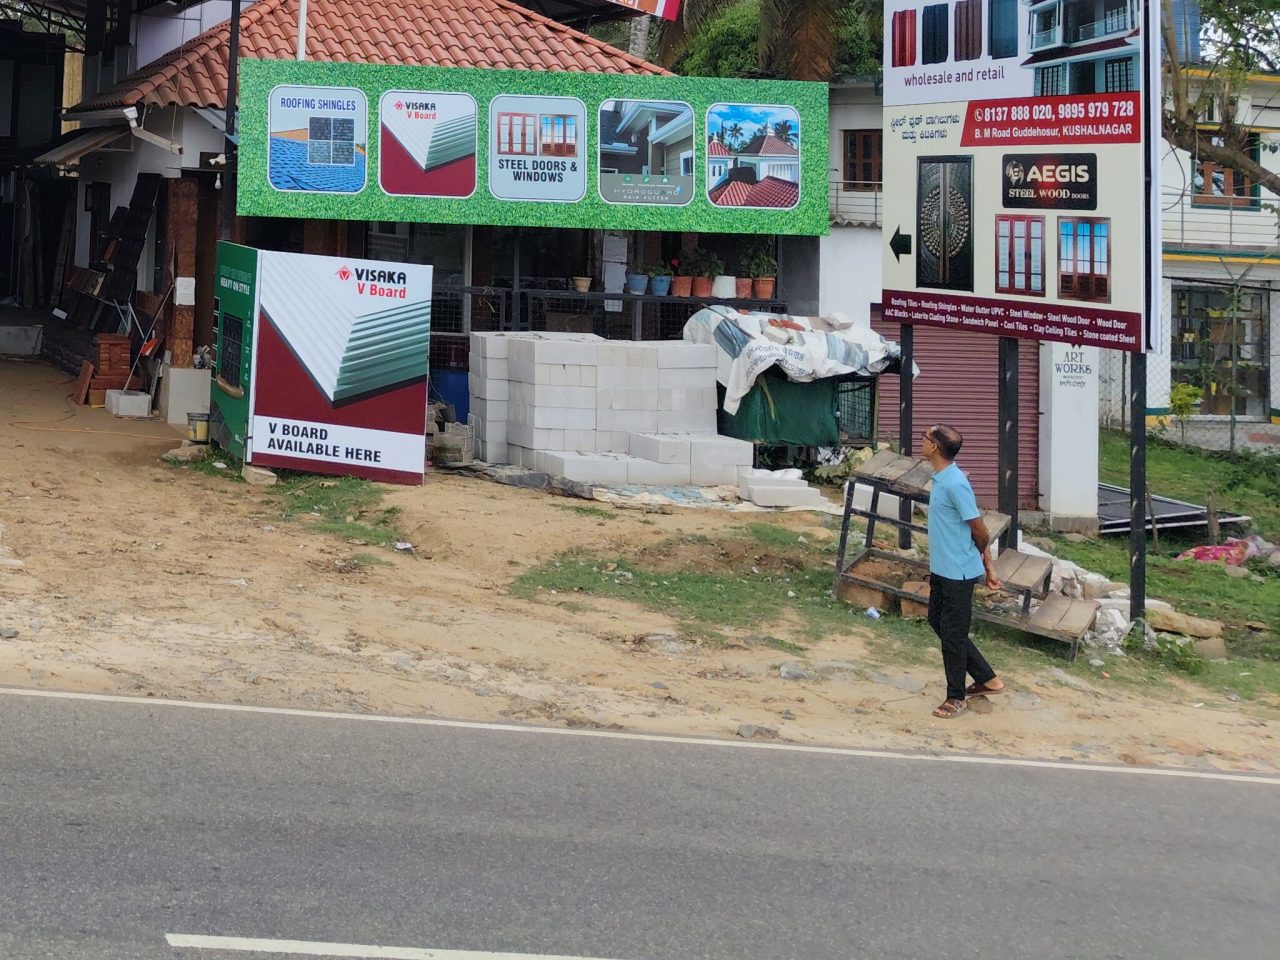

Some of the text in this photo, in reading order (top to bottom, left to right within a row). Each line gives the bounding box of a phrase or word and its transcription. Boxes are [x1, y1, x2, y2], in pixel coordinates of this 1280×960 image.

[904, 65, 1005, 87] wholesale and retail
[280, 97, 356, 111] ROOFING SHINGLES
[405, 101, 436, 111] VISAKA
[984, 100, 1134, 122] 8137 888 020, 9895 979 728
[407, 111, 437, 120] V Board
[974, 123, 1132, 139] B. M Road Guddehosur, KUSHALNAGAR
[498, 159, 577, 172] STEEL DOORS &
[513, 170, 564, 183] WINDOWS
[1027, 165, 1089, 183] AEGIS
[1008, 189, 1037, 198] STEEL
[1039, 189, 1070, 199] WOOD
[354, 267, 406, 285] VISAKA
[357, 282, 406, 299] V Board
[885, 308, 894, 316] AAC
[962, 316, 985, 326] Sandwich
[985, 318, 999, 327] Panel
[1015, 322, 1028, 331] Tiles
[1064, 327, 1077, 337] Tiles
[1083, 329, 1099, 340] Stone
[1099, 331, 1118, 342] coated
[1119, 333, 1136, 344] Sheet
[991, 307, 1004, 315] UPVC
[1009, 309, 1023, 318] Steel
[1023, 310, 1043, 320] Window
[1047, 312, 1061, 322] Steel
[1061, 314, 1077, 324] Wood
[1077, 316, 1091, 325] Door
[1096, 318, 1113, 328] Wood
[1113, 320, 1127, 330] Door
[1064, 352, 1084, 363] ART
[1055, 364, 1092, 375] WORKS
[268, 422, 328, 440] V BOARD
[267, 437, 382, 463] AVAILABLE HERE
